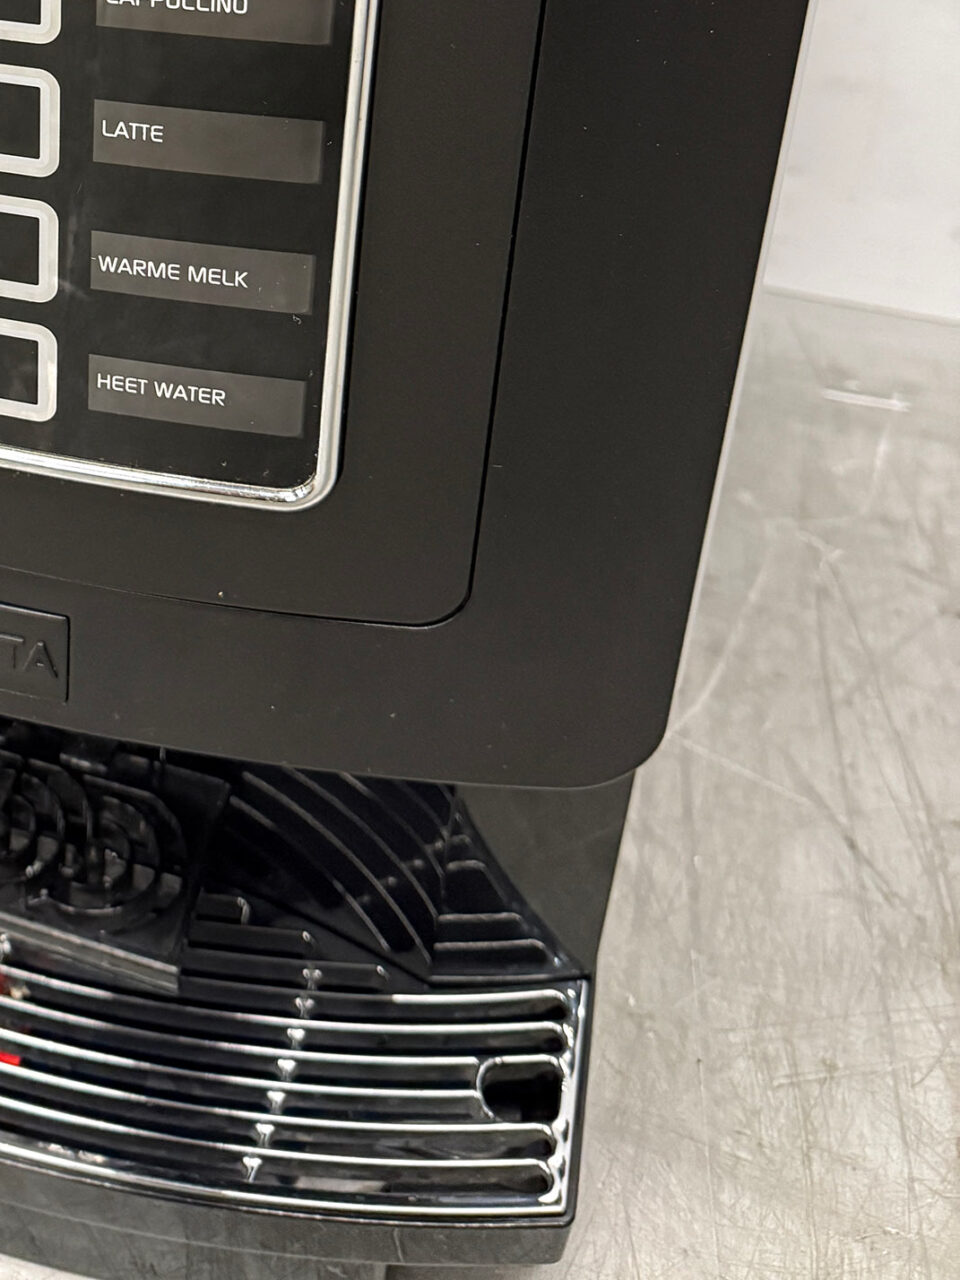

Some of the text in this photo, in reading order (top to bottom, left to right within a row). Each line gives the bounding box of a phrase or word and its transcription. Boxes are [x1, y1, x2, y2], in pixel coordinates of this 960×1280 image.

[101, 119, 165, 144] LATTE
[97, 254, 249, 290] WARME MELK
[96, 372, 227, 407] HEET WATER
